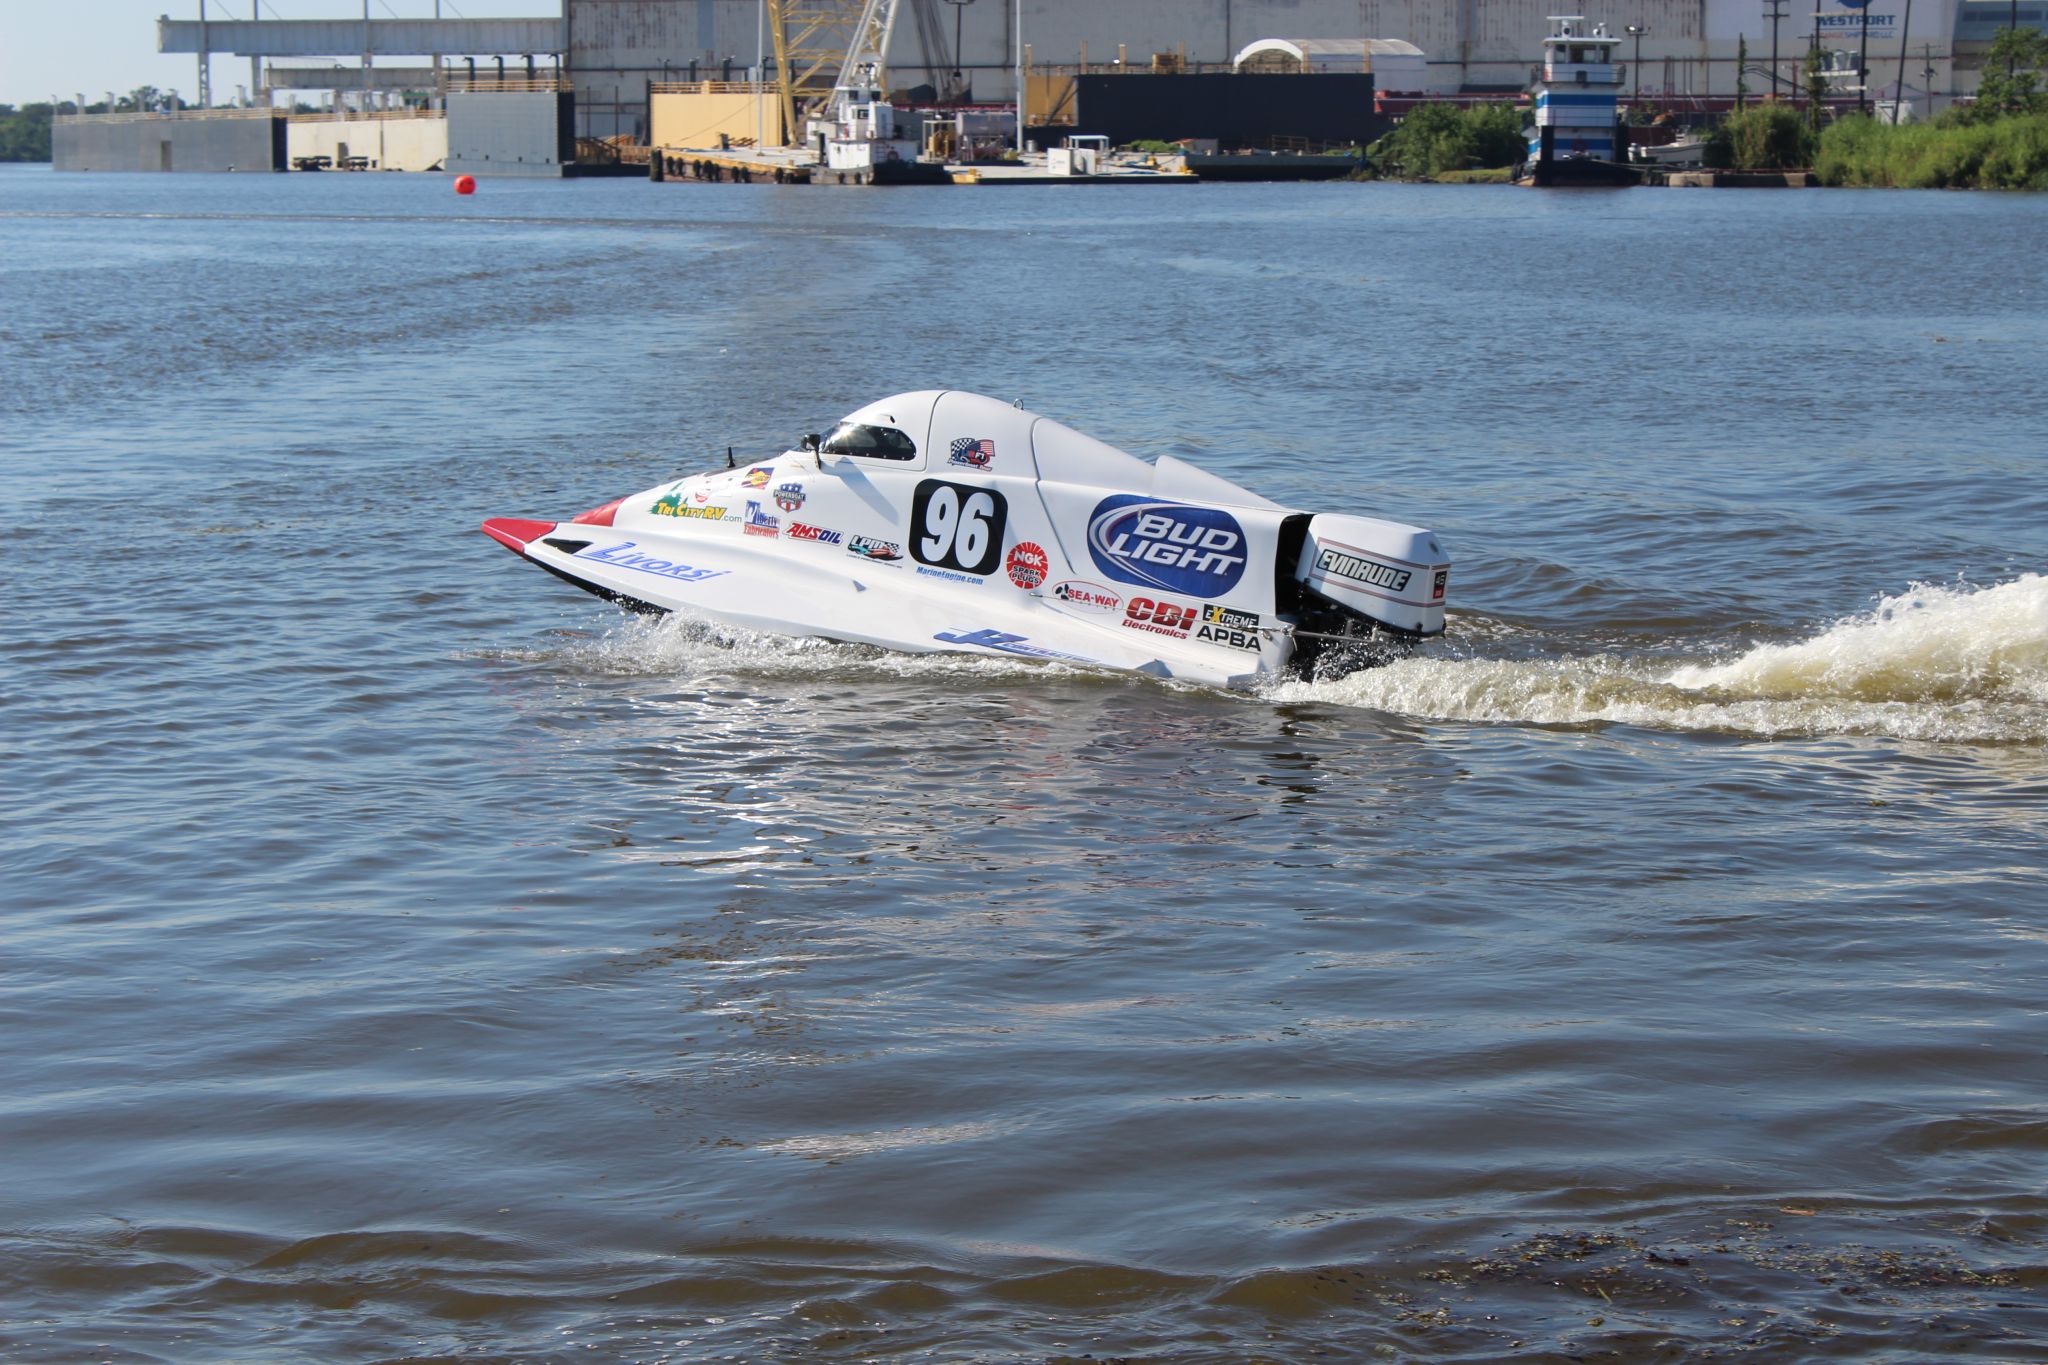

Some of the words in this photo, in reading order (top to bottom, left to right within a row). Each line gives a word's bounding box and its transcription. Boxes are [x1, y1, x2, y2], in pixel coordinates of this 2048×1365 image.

[1816, 15, 1896, 26] WESTPORT
[787, 522, 841, 544] AMSOIL
[921, 485, 994, 569] 96
[1133, 513, 1239, 551] BUD
[1014, 550, 1042, 566] NGK
[1107, 533, 1244, 576] LIGHT
[916, 566, 984, 585] MarineEngine.com
[1012, 565, 1041, 576] SPARK
[1012, 573, 1040, 584] PLUGS
[1318, 550, 1410, 591] EVINRUDE
[1067, 588, 1119, 608] SEA-WAY
[1126, 597, 1198, 631] CDI
[1205, 606, 1258, 627] EXTREME
[1122, 619, 1189, 640] Electronics
[1196, 625, 1262, 652] APBA
